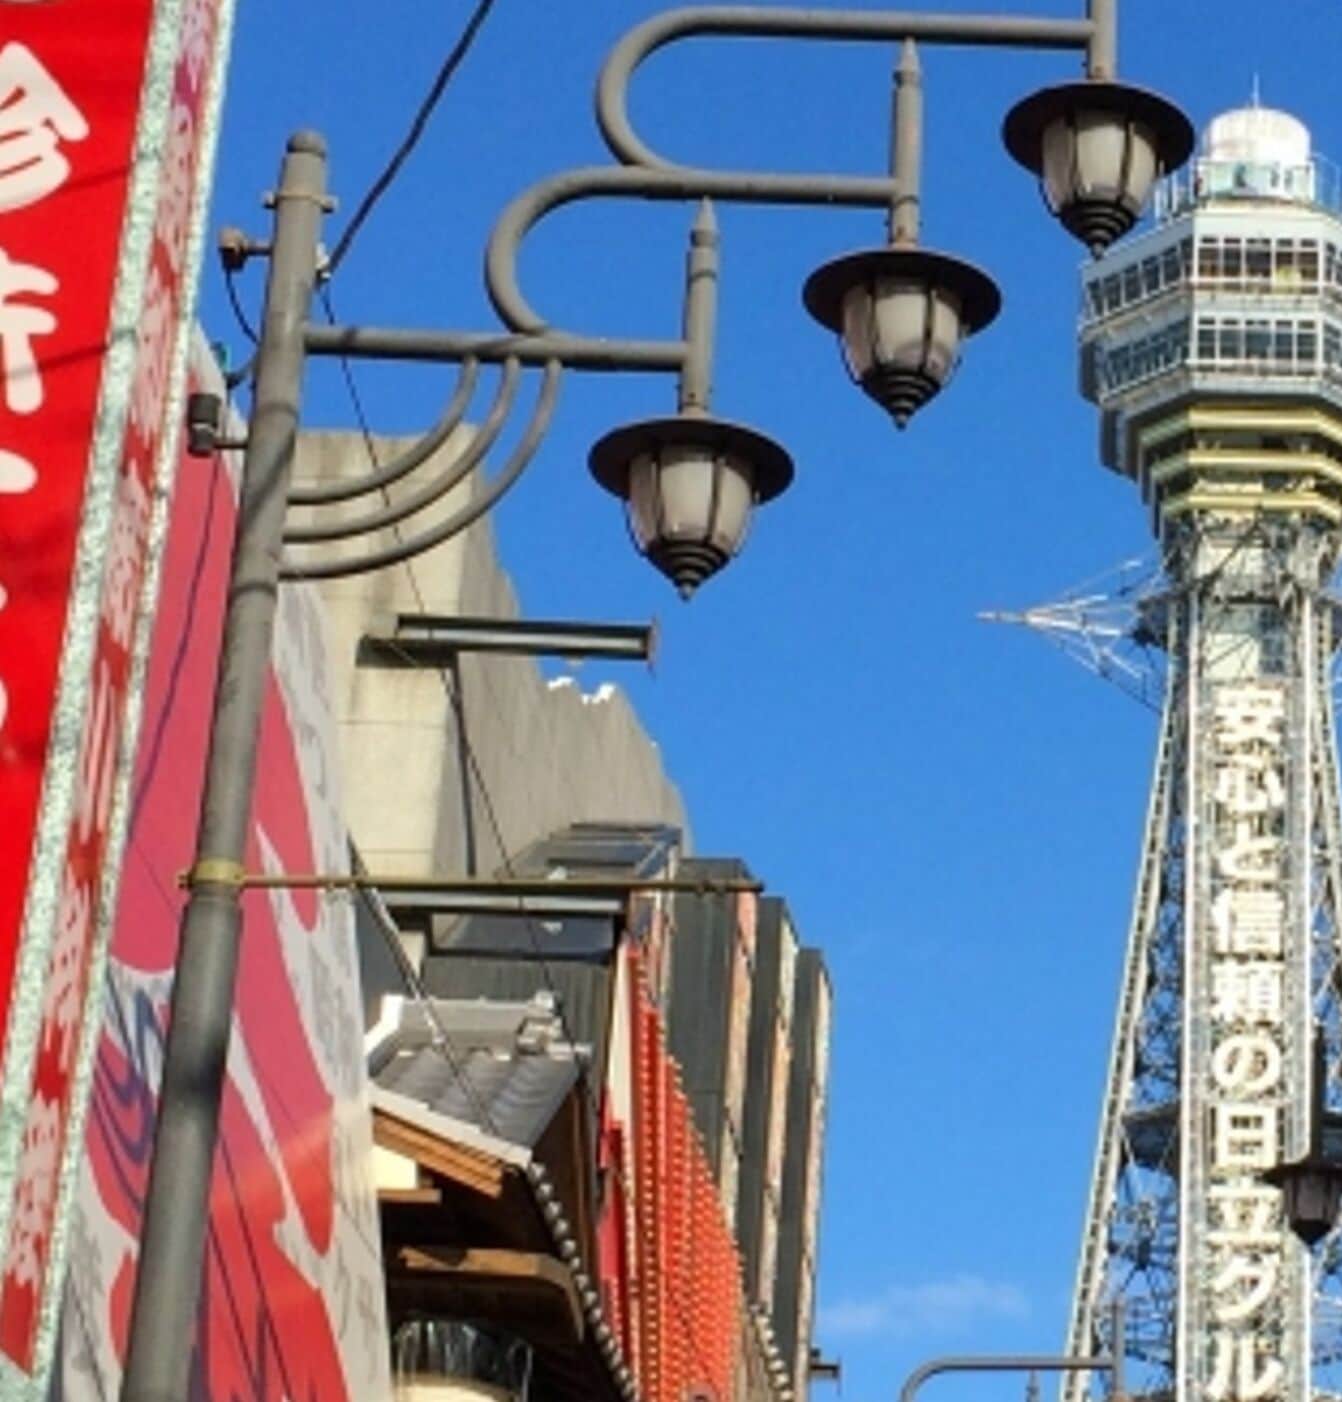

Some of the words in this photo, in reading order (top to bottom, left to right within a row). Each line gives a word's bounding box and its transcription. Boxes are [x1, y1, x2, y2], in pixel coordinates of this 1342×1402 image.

[1206, 682, 1286, 1402] 安心と信頼の日立グル
